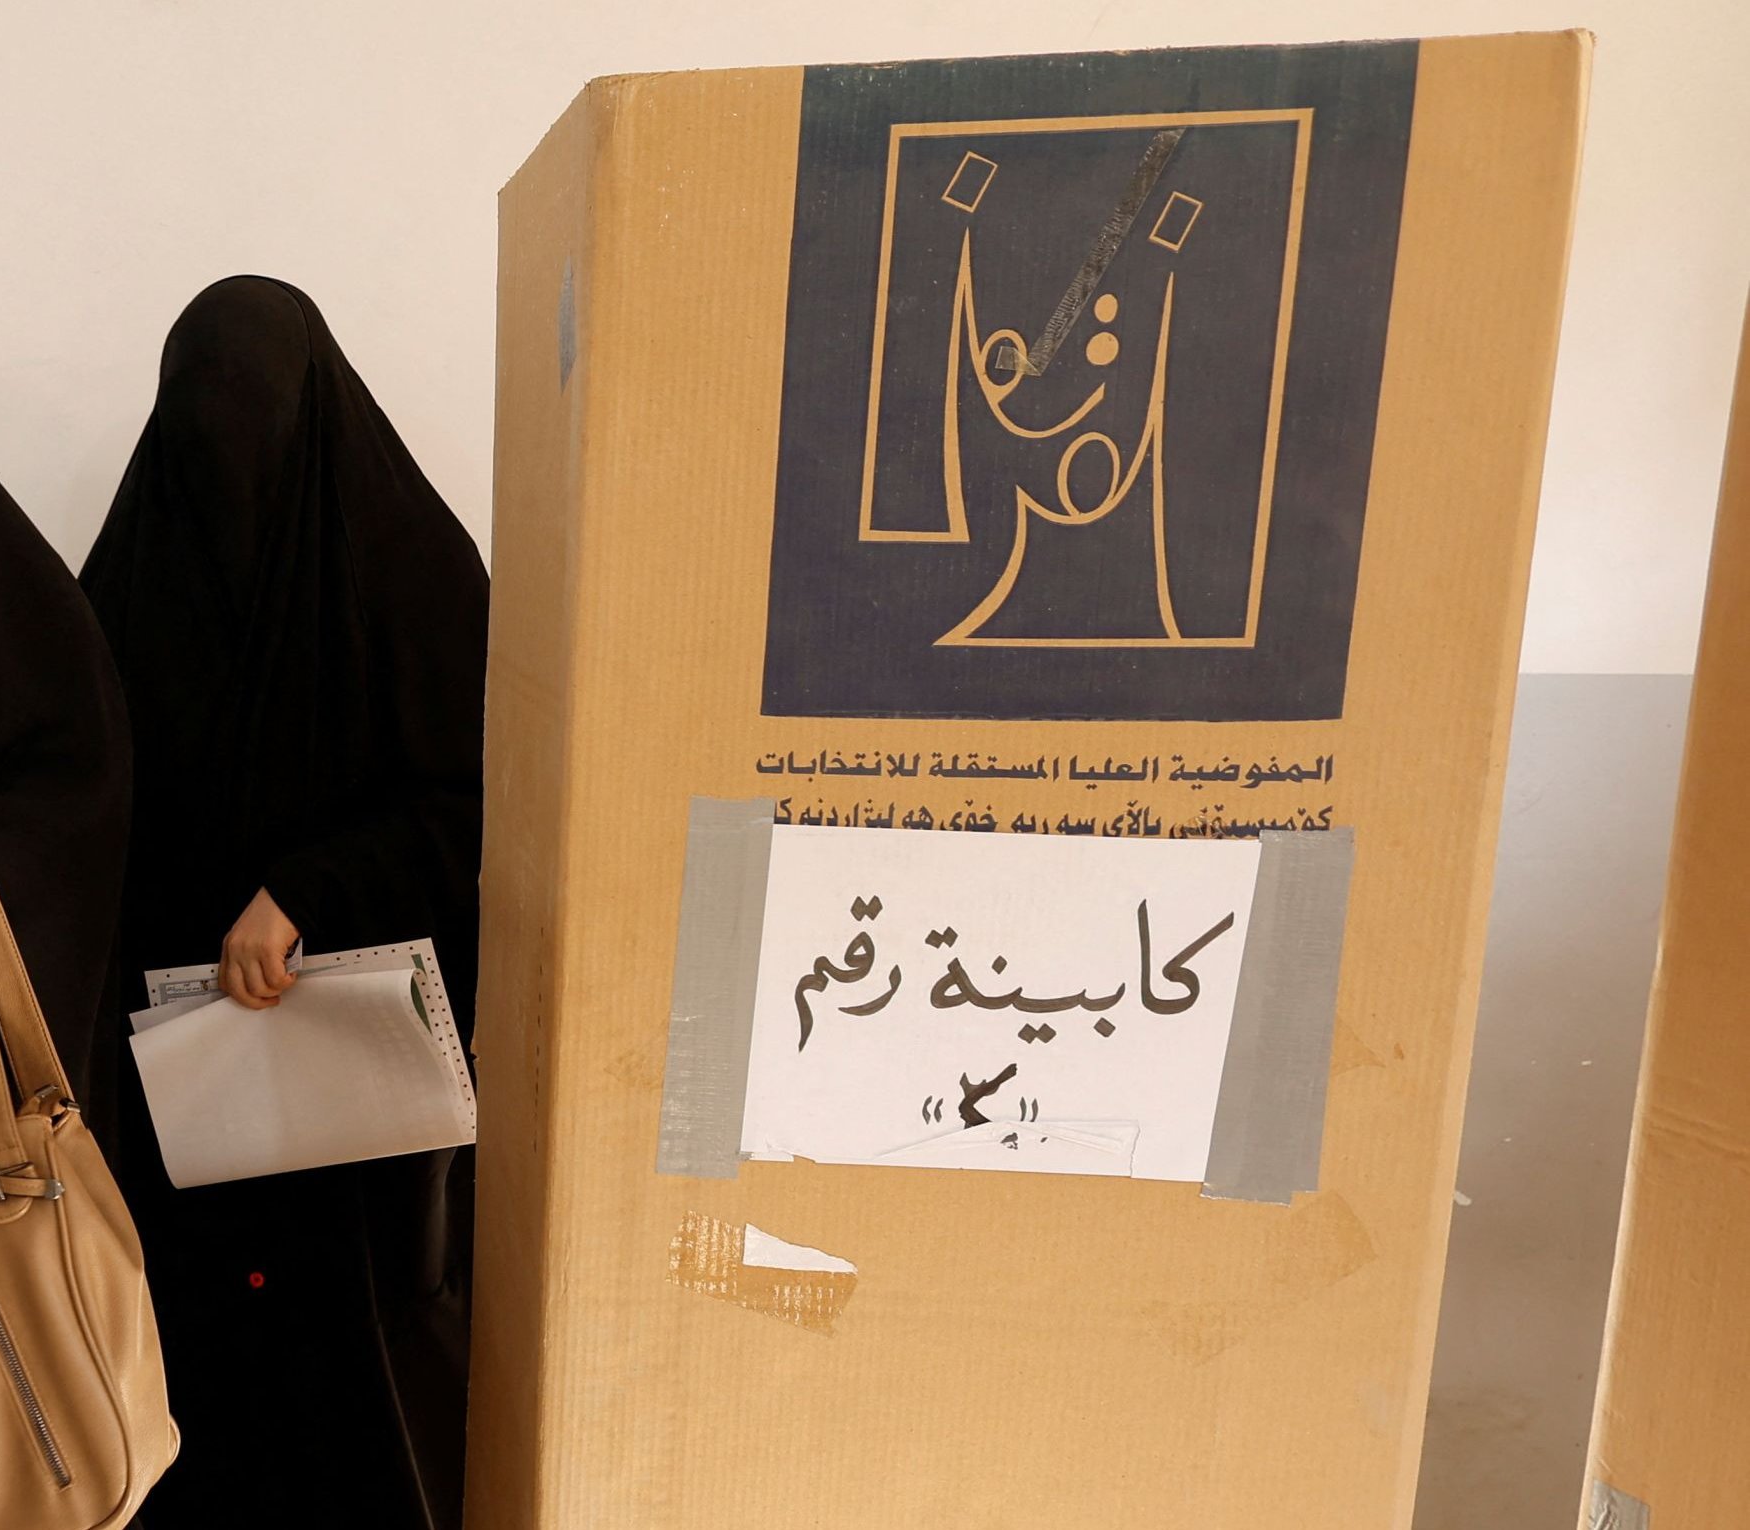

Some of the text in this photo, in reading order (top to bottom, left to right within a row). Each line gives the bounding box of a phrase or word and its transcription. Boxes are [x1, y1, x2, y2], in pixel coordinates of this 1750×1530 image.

[755, 749, 1334, 791] المفوضية العليا المستقلة للانتخابات
[794, 895, 1235, 1053] كابينة رقم
